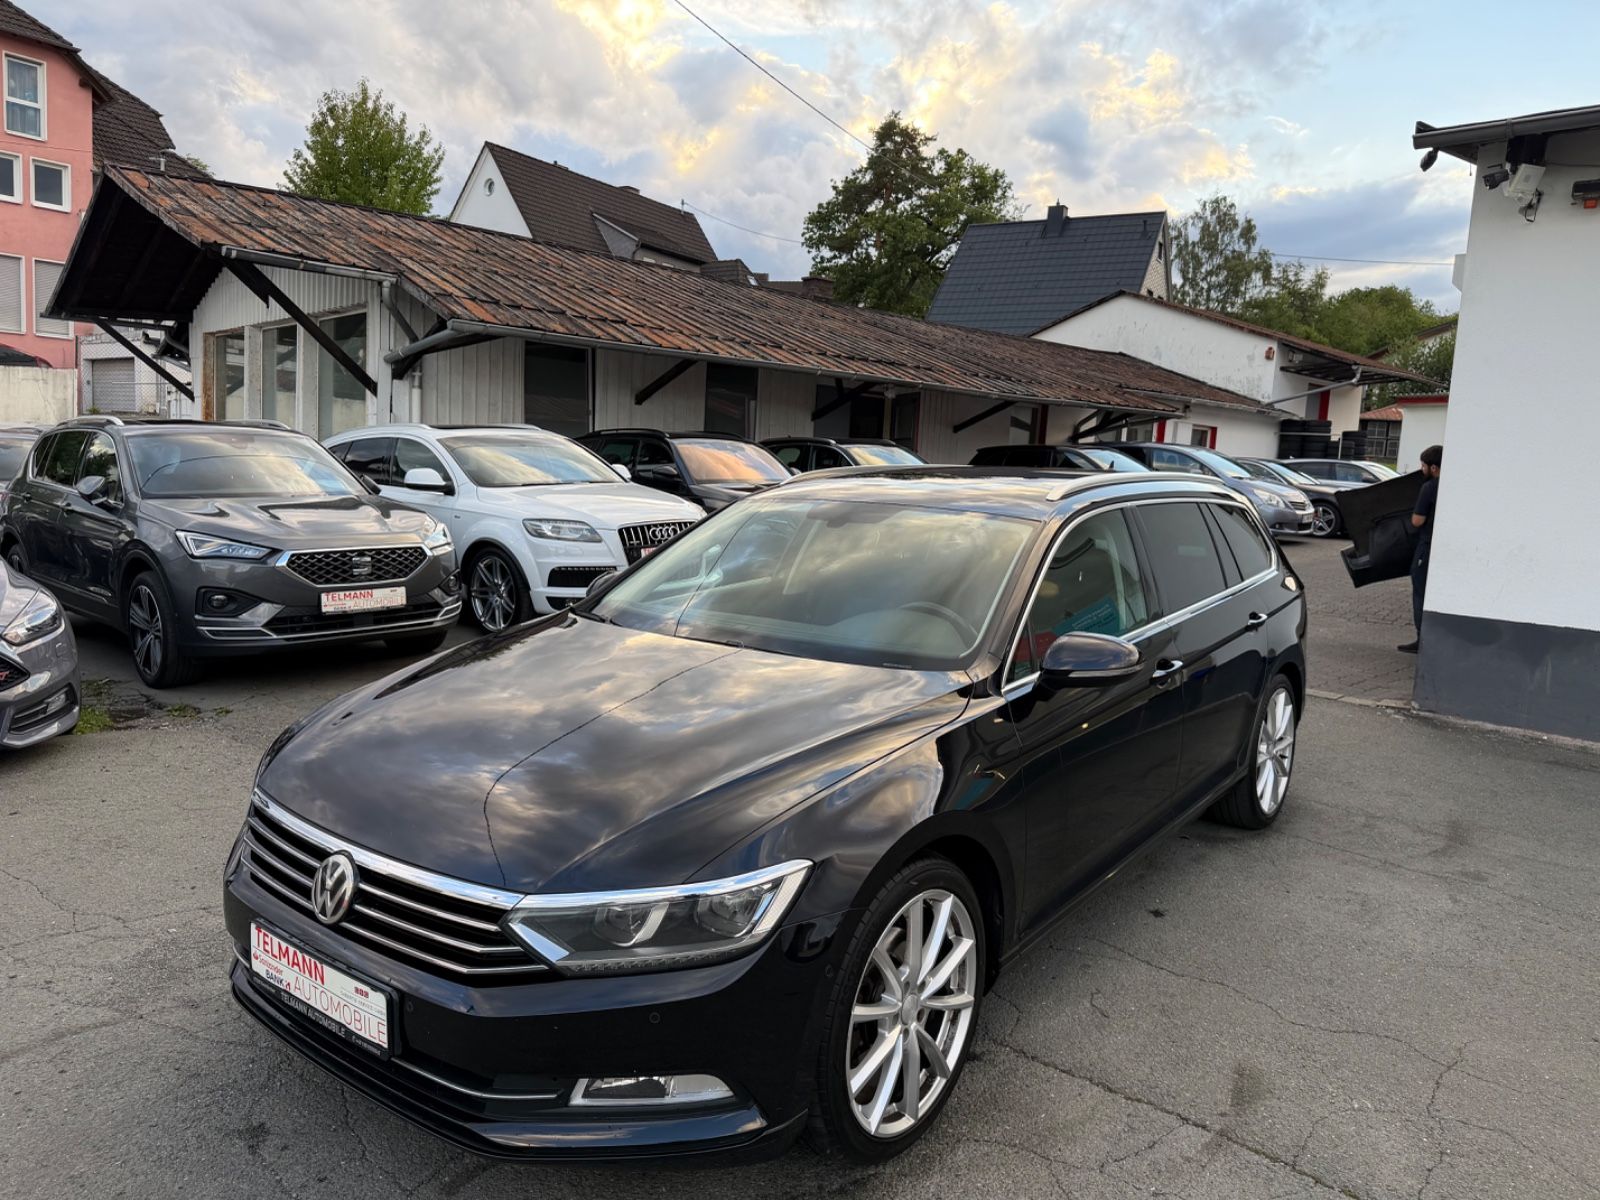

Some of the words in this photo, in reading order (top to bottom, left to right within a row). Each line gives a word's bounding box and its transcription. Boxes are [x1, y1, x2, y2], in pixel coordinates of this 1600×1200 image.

[325, 590, 373, 602] TELMANN
[255, 927, 324, 985] TELMANN
[265, 969, 285, 988] BANK
[280, 992, 307, 1017] TELMANN
[308, 1008, 345, 1039] AUTOMOBILE
[294, 976, 387, 1044] AUTOMOBILE
